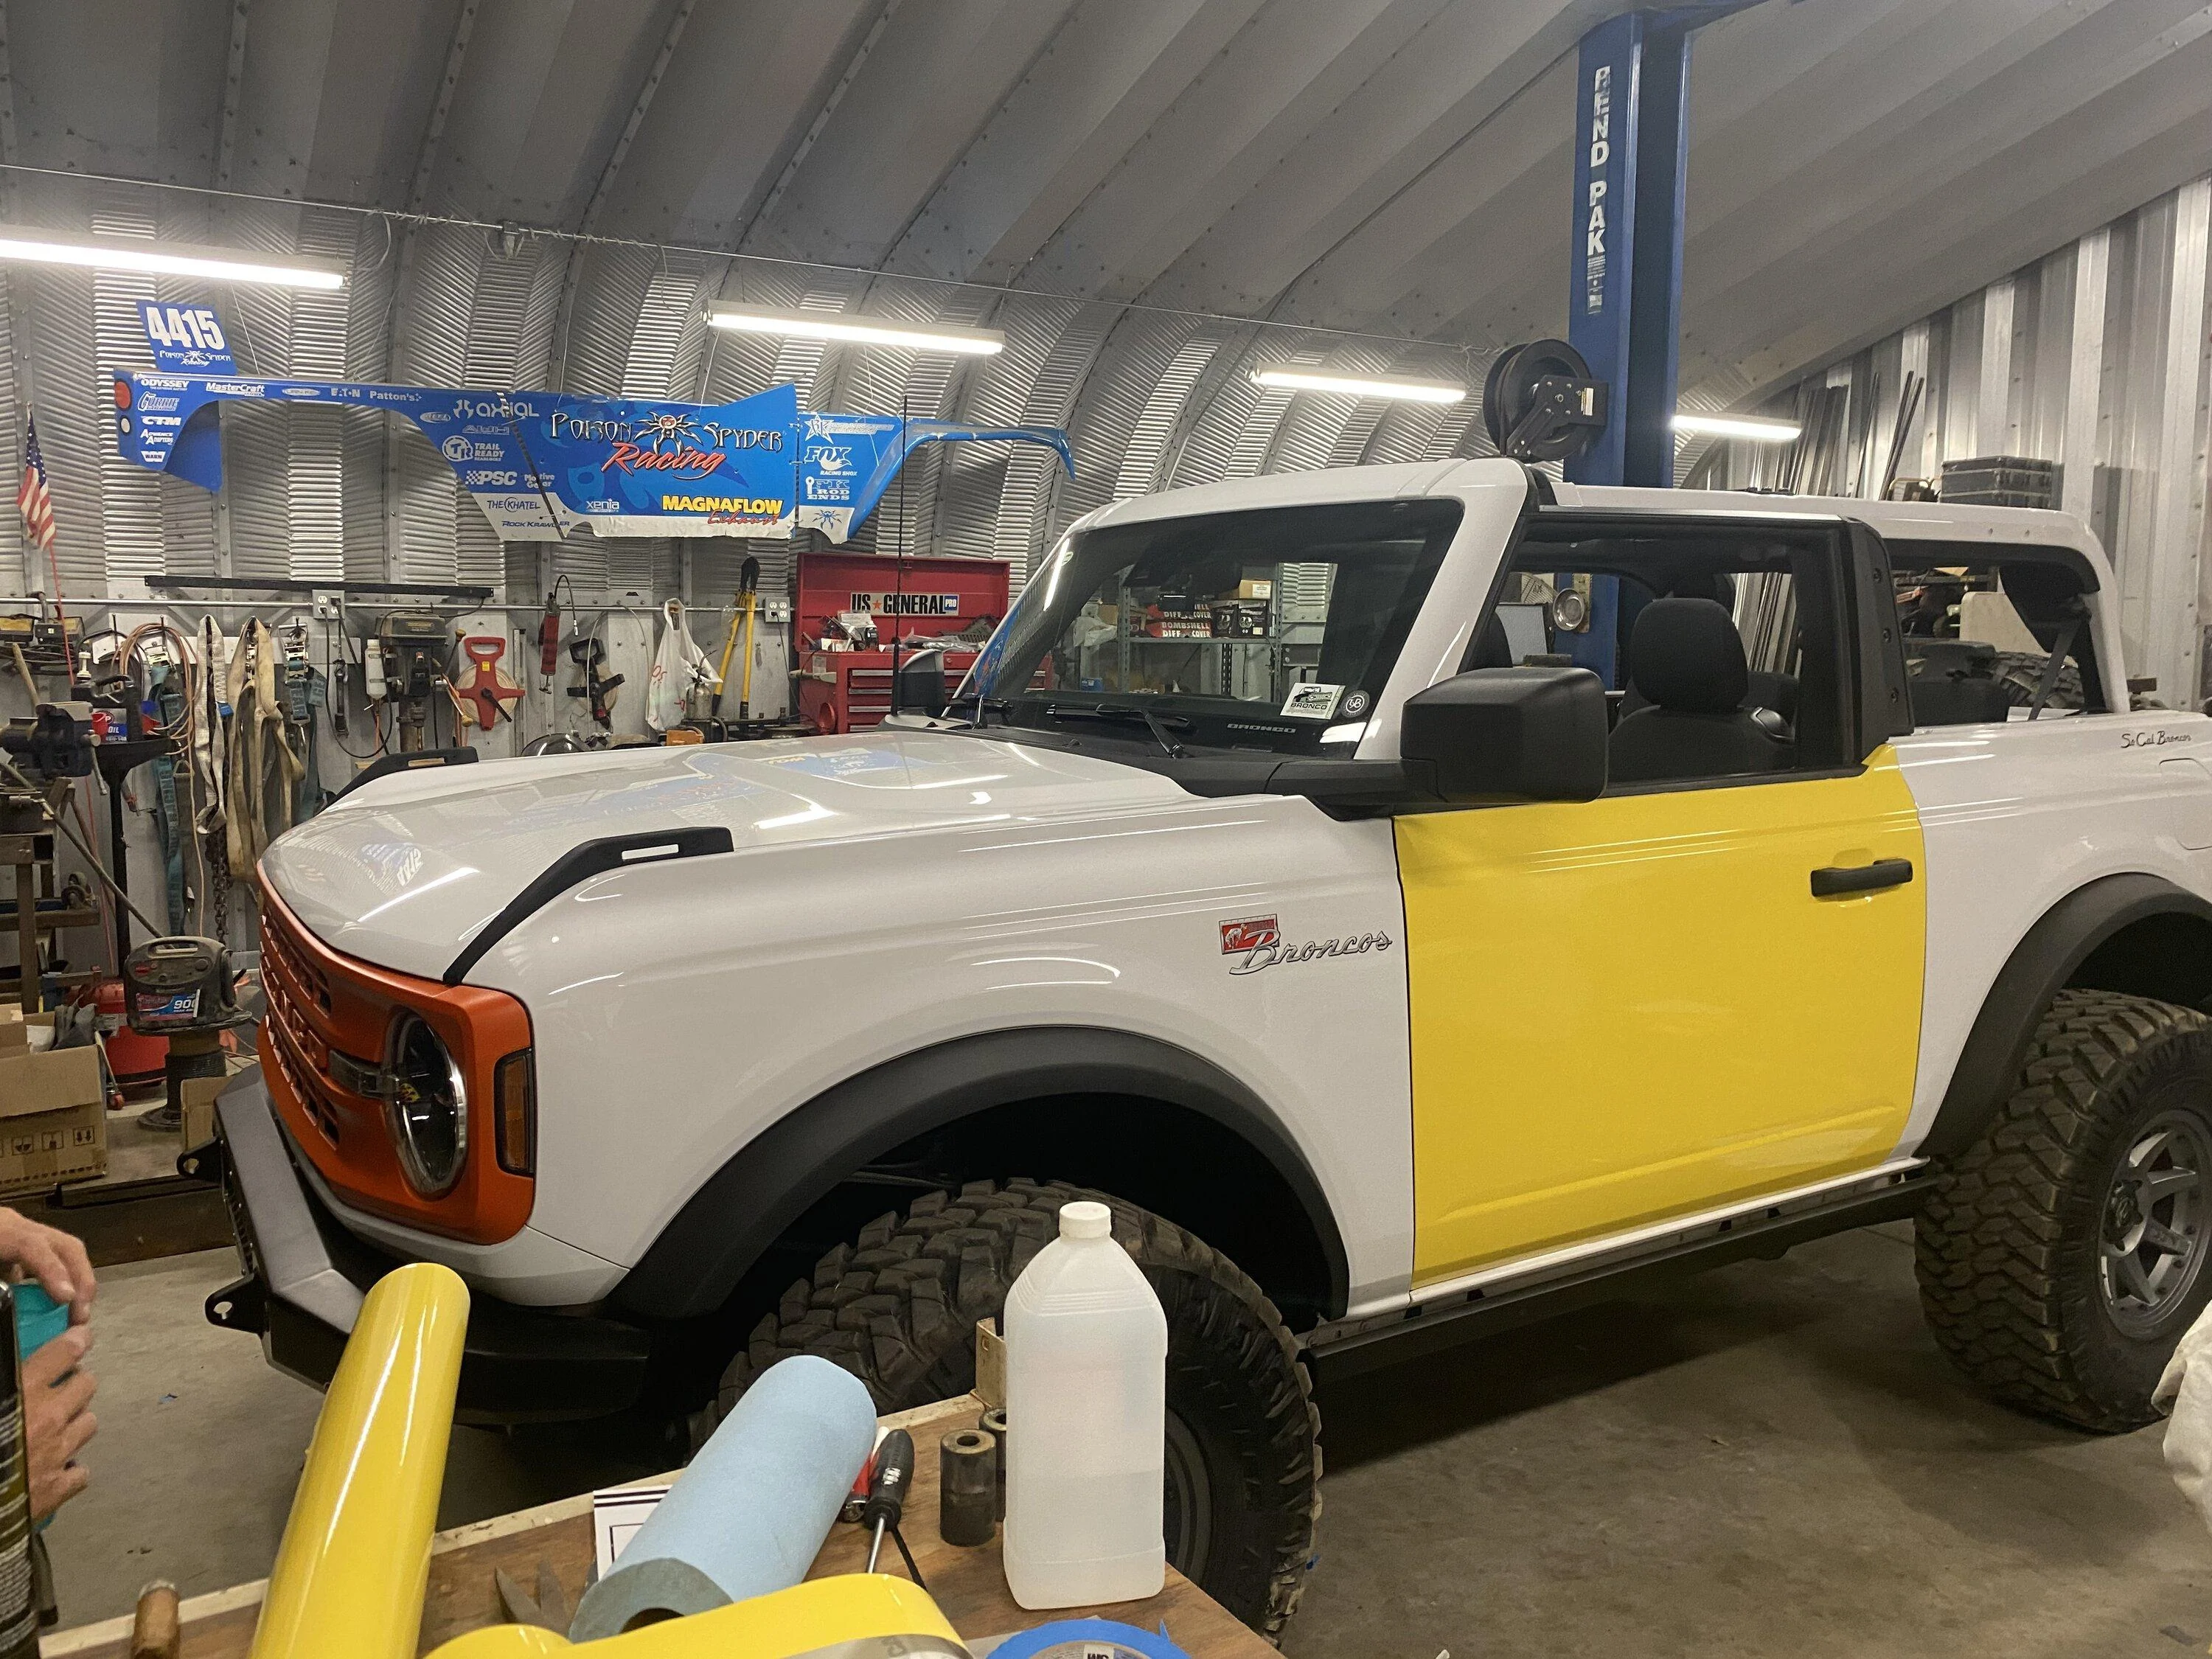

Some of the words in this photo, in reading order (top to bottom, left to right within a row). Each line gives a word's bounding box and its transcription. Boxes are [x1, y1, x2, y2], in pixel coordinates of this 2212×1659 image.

[1587, 180, 1607, 256] PAK
[146, 307, 225, 350] 4415
[141, 378, 189, 388] ODYSSEY
[206, 383, 265, 393] MasterCraft
[369, 391, 414, 401] Patton's
[551, 412, 633, 442] POISON
[703, 422, 784, 453] SPYDER
[600, 441, 728, 481] Racing
[804, 446, 852, 465] FOX
[479, 470, 517, 485] PSC
[585, 498, 620, 509] xenia
[661, 495, 783, 515] MAGNAFLOW
[852, 594, 871, 611] US
[883, 594, 946, 614] GENERAL
[945, 599, 957, 608] PRO
[1192, 630, 1211, 638] COVER
[1290, 702, 1327, 710] BRONCO
[108, 726, 119, 734] OIL
[1229, 929, 1393, 975] Broncos
